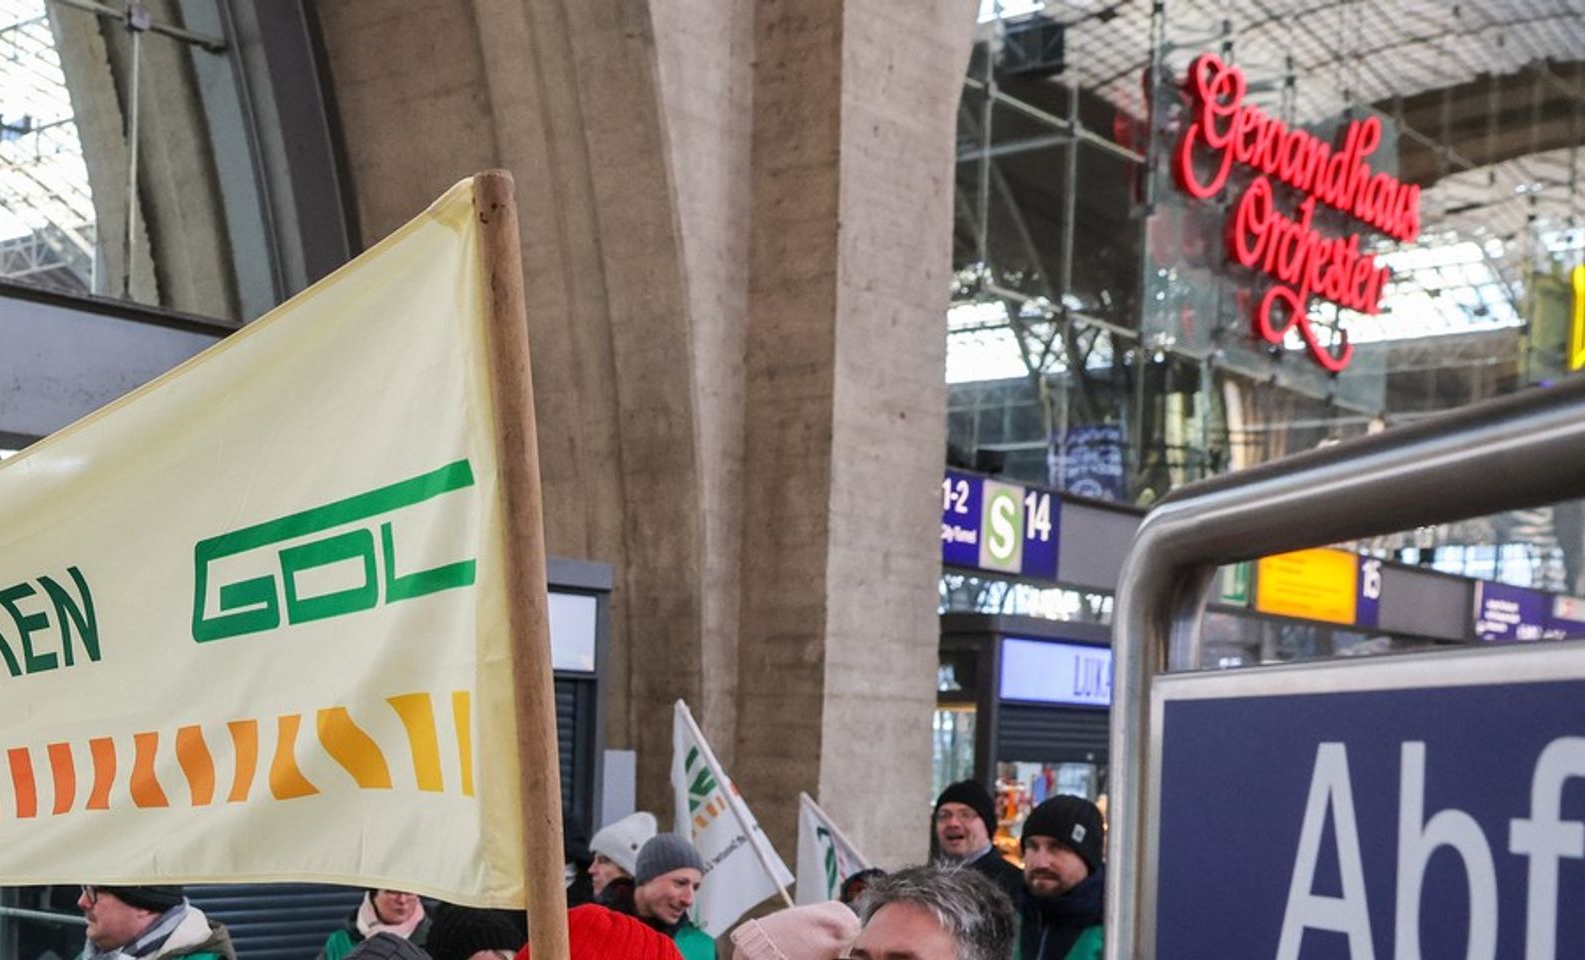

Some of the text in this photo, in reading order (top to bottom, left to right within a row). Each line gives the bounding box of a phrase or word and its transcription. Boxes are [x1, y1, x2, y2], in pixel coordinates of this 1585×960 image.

[1176, 54, 1421, 243] Gewandhaus
[1230, 176, 1390, 371] Orchester
[192, 458, 476, 643] GDL
[988, 495, 1015, 559] S
[1025, 490, 1052, 542] 14
